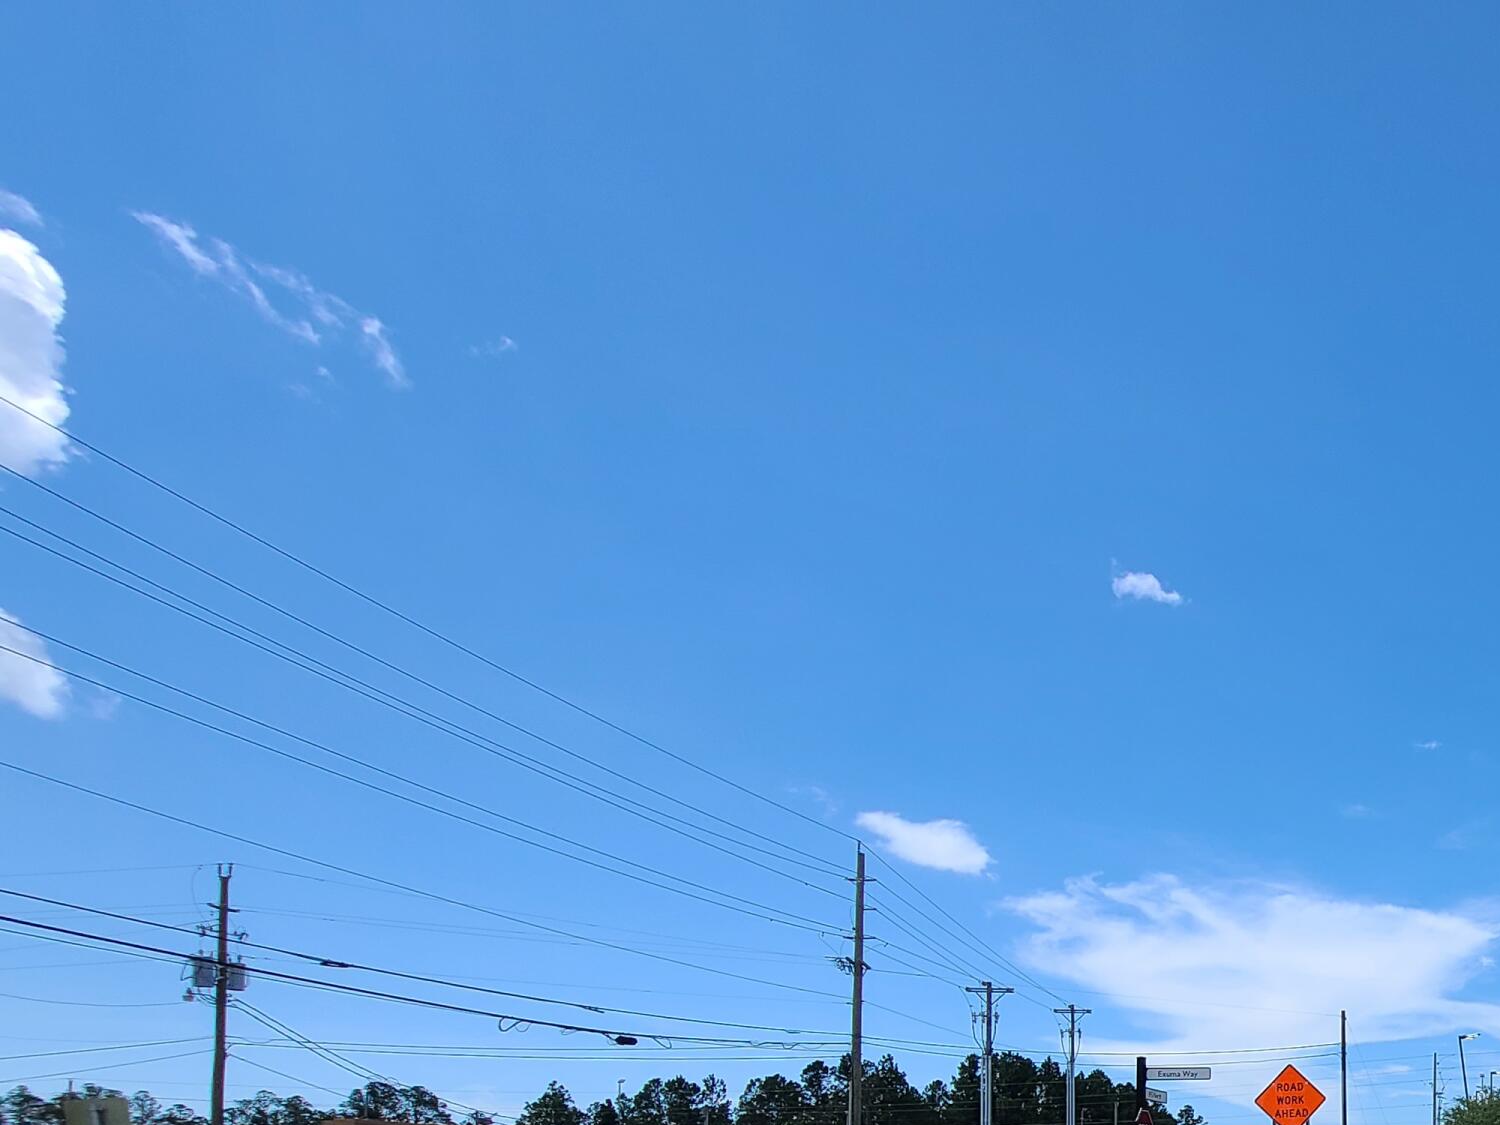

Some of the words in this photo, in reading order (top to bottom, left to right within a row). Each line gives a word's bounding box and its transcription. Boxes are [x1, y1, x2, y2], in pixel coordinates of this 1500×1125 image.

[1157, 1070, 1180, 1078] Exuma
[1182, 1070, 1198, 1079] Way
[1276, 1082, 1304, 1092] ROAD
[1276, 1095, 1304, 1105] WORK
[1275, 1108, 1309, 1118] AHEAD
